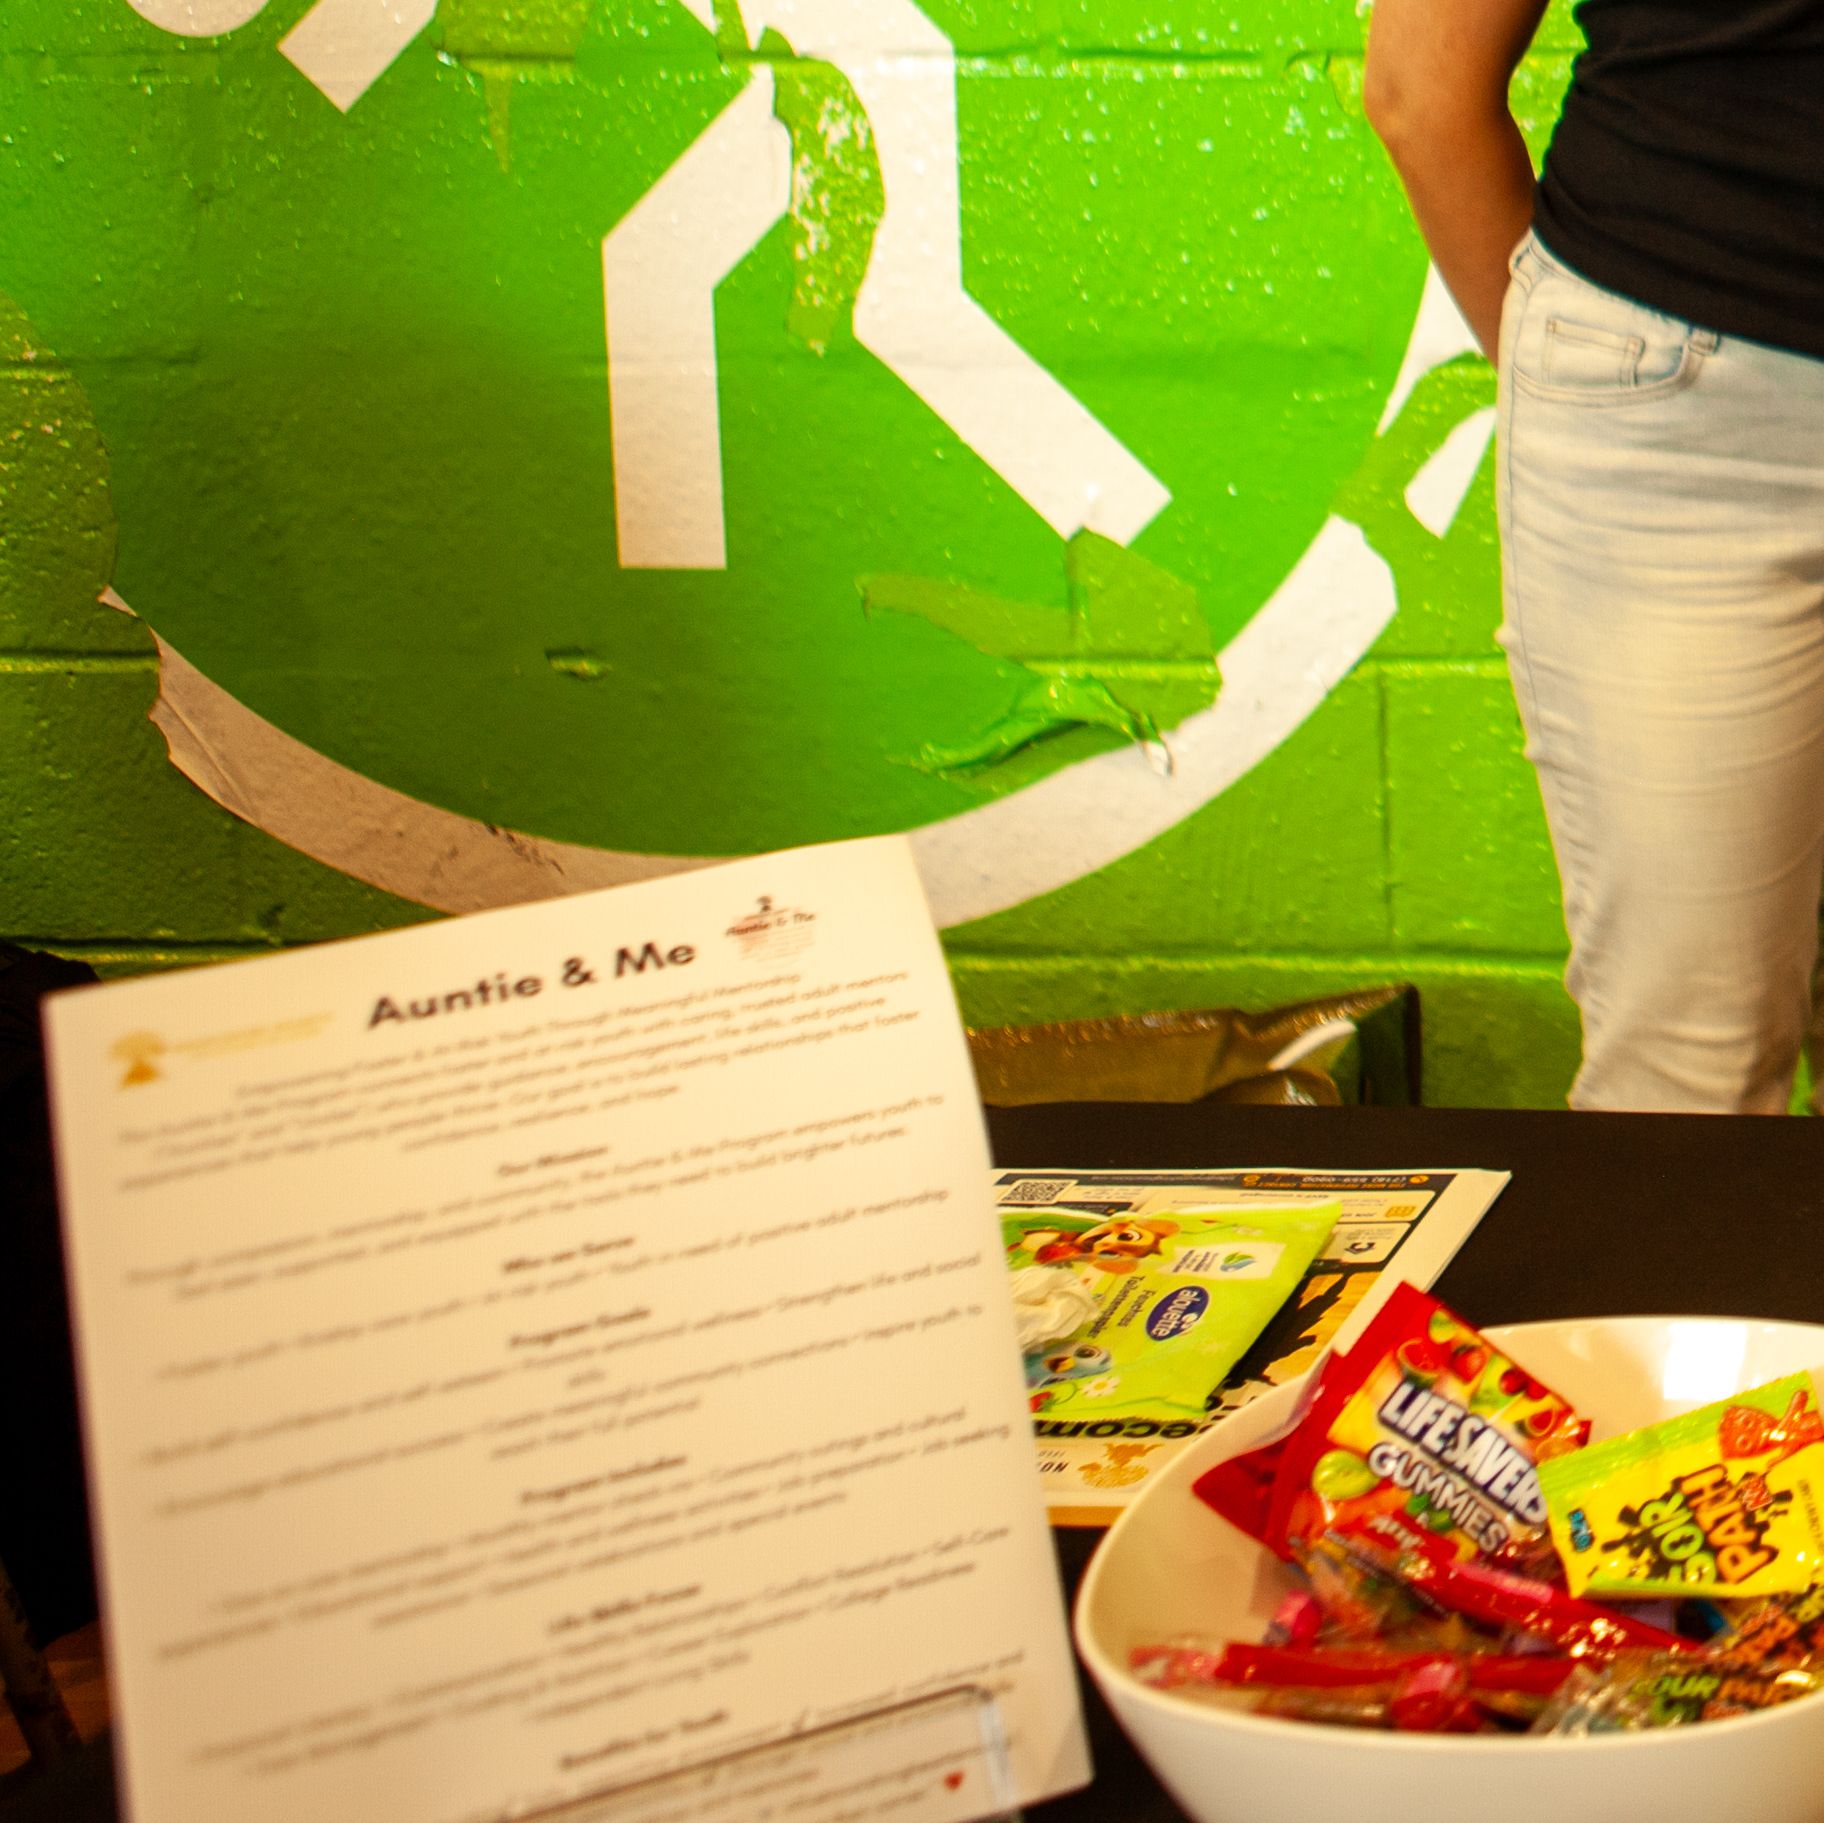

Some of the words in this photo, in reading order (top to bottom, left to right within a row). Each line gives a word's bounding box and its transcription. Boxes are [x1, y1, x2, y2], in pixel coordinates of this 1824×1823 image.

[367, 969, 544, 1029] Auntie
[561, 955, 599, 988] &
[612, 940, 698, 979] Me
[1151, 1288, 1199, 1338] alouette
[1368, 1441, 1510, 1554] GUMMIES
[1679, 1462, 1780, 1585] PATCH
